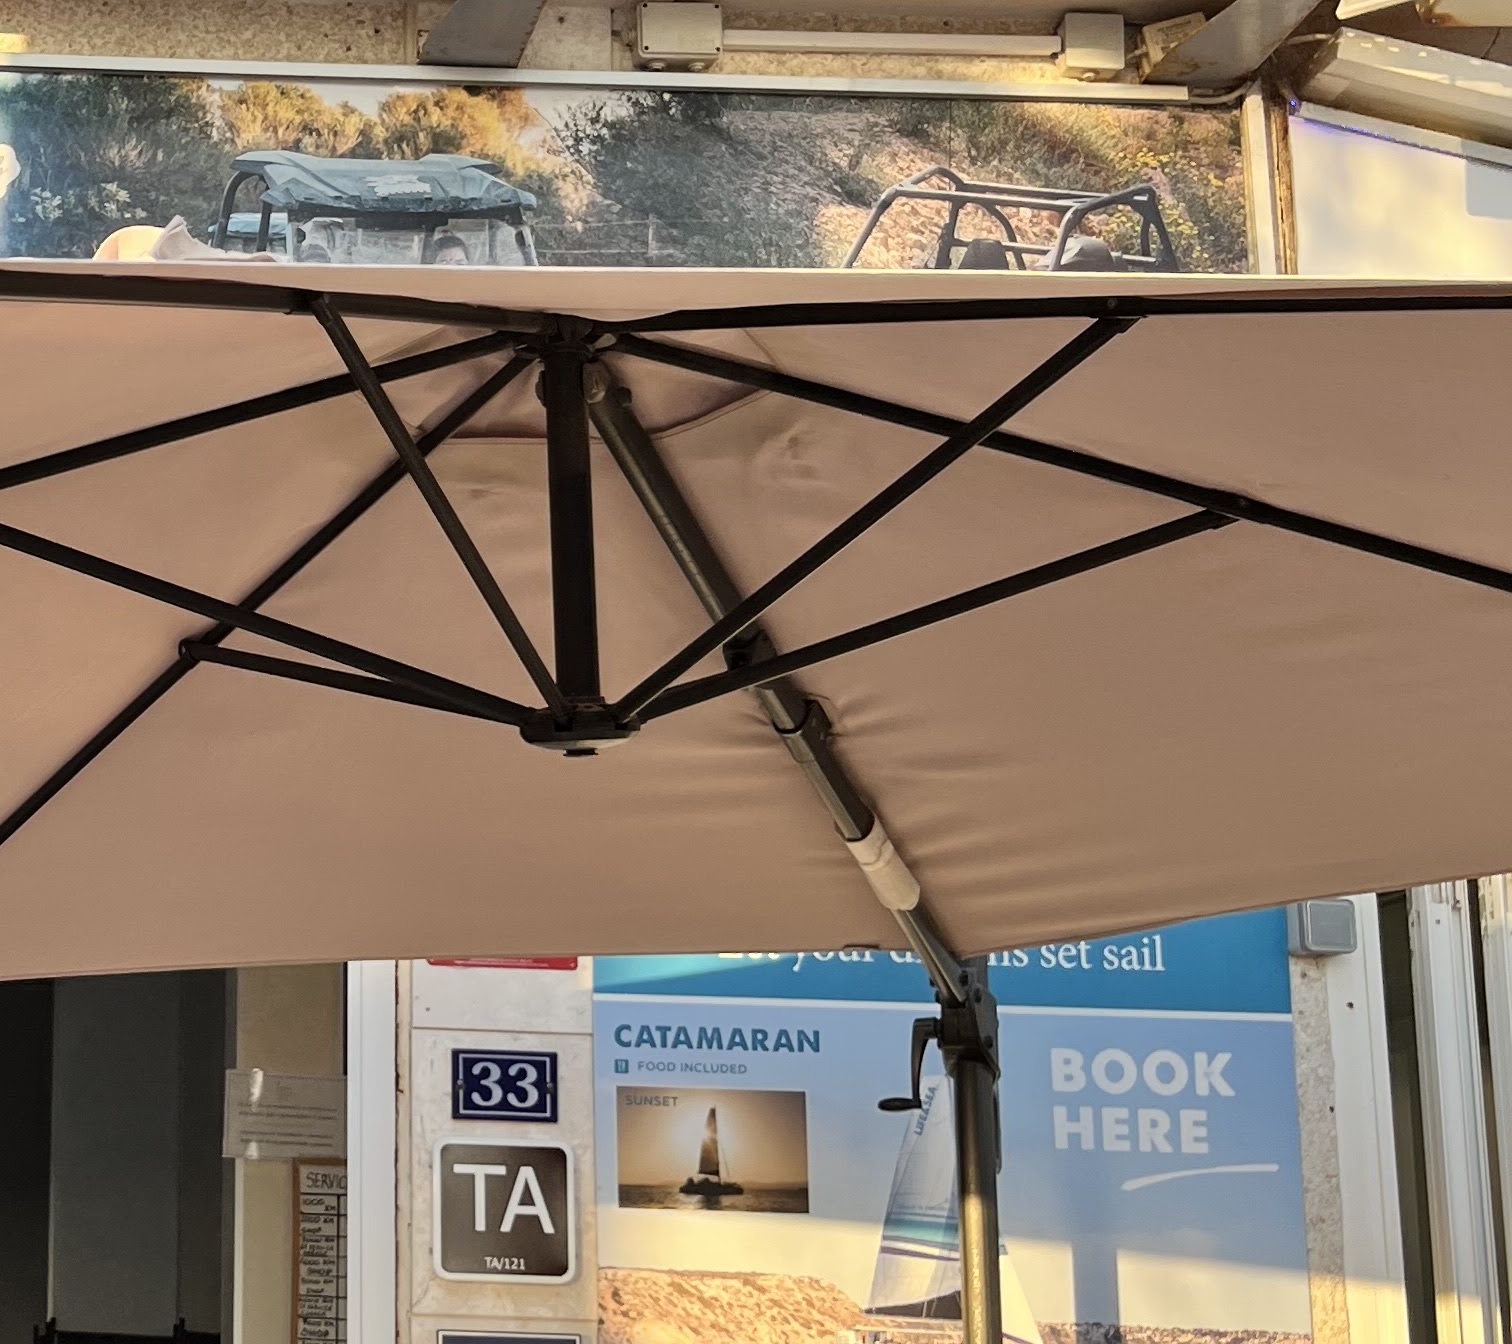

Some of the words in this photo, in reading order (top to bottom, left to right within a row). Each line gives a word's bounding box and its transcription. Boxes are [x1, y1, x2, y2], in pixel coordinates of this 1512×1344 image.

[1040, 940, 1092, 969] set
[1103, 934, 1165, 971] sail
[614, 1023, 821, 1053] CATAMARAN
[470, 1061, 539, 1108] 33
[637, 1061, 676, 1072] FOOD
[680, 1062, 748, 1074] INCLUDED
[1050, 1047, 1236, 1097] BOOK
[625, 1095, 679, 1107] SUNSET
[1053, 1105, 1210, 1155] HERE
[452, 1163, 555, 1234] TA
[484, 1256, 525, 1271] TA/121
